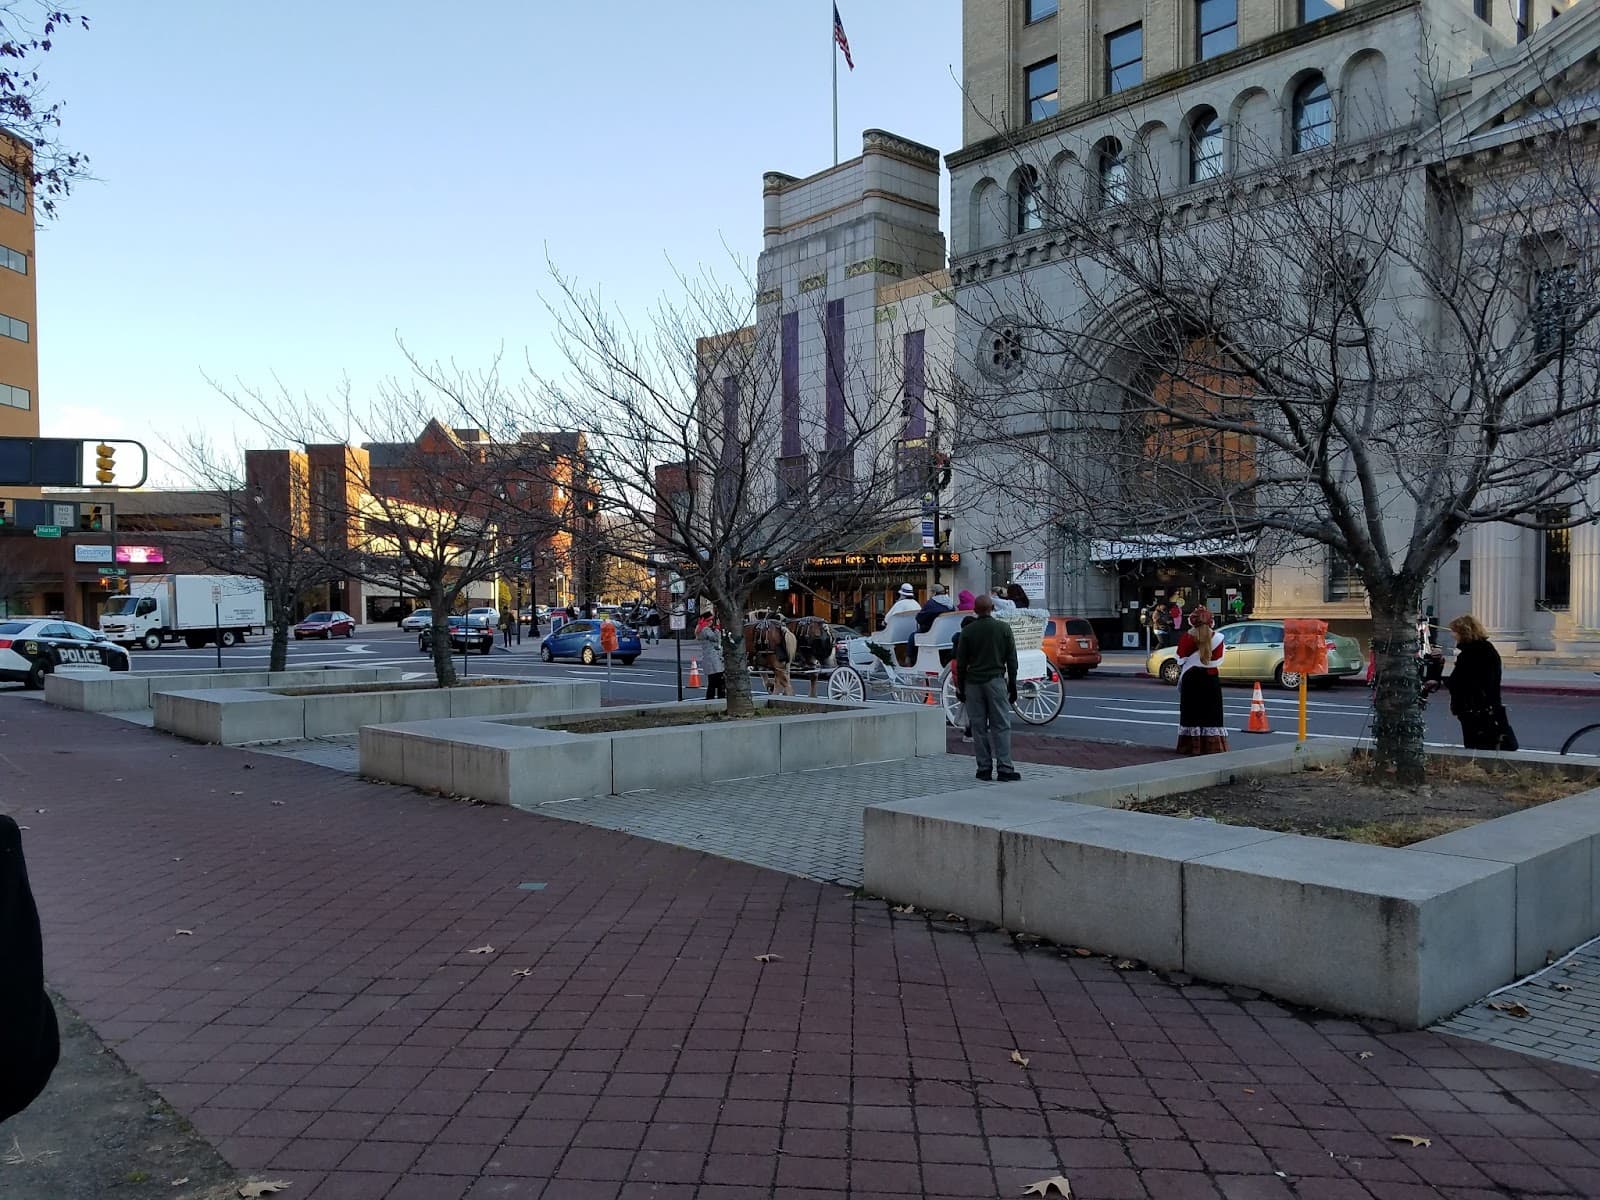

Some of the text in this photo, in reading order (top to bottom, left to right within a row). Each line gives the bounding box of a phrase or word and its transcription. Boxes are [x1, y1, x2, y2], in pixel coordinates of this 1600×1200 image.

[845, 554, 867, 564] Arts
[877, 553, 916, 565] December
[920, 553, 927, 562] 6
[58, 648, 102, 663] POLICE
